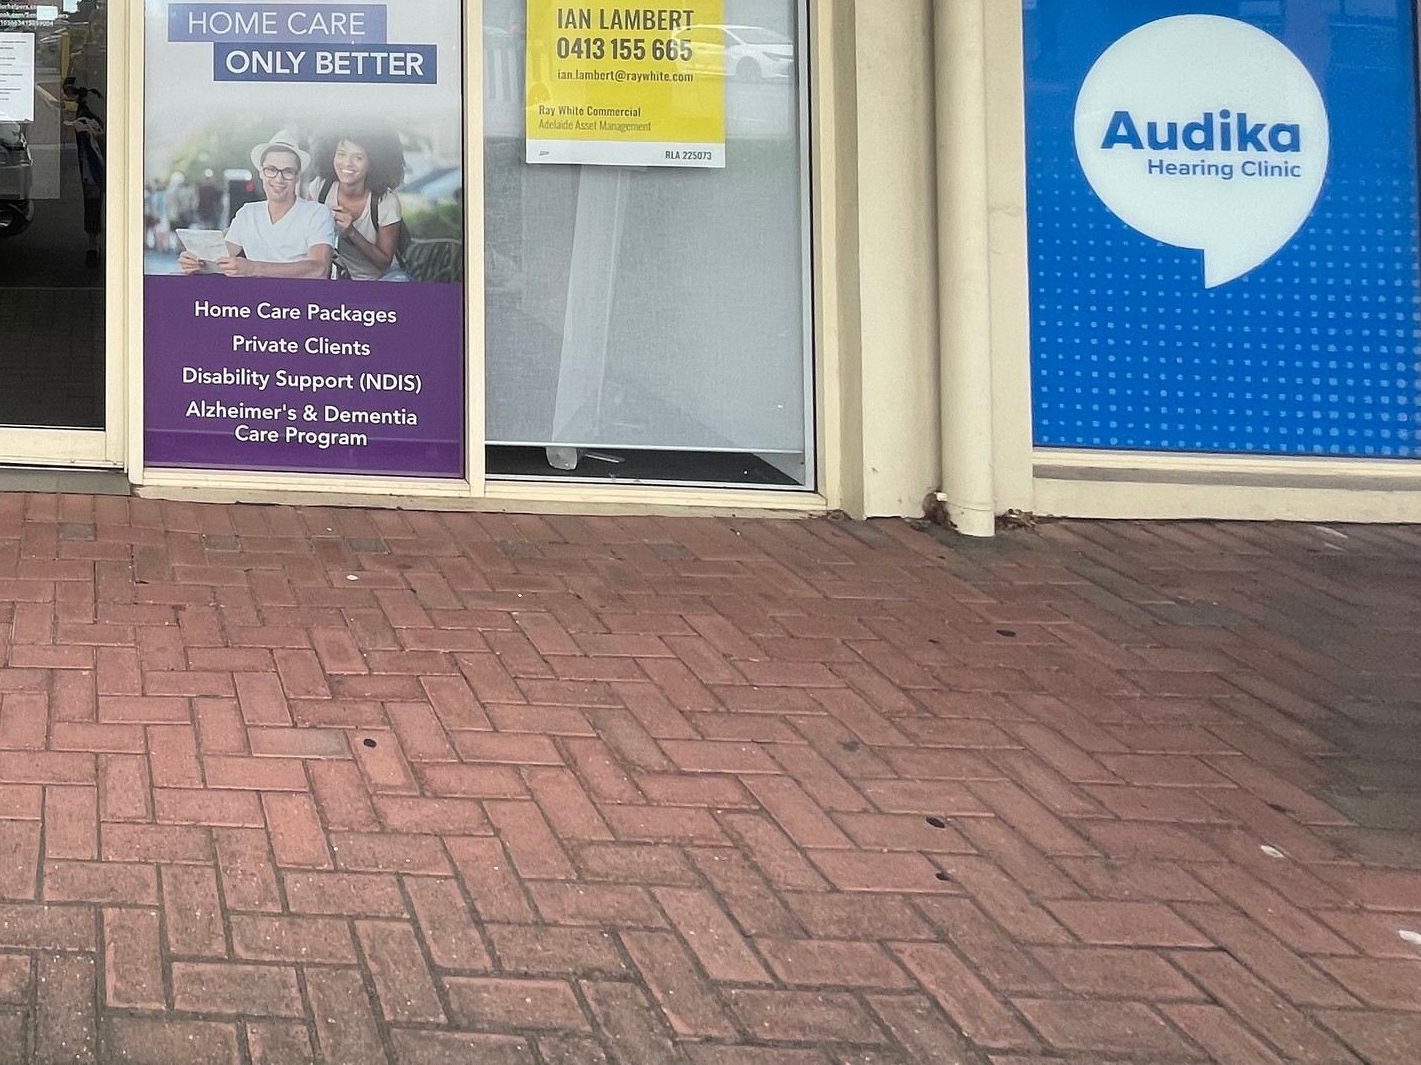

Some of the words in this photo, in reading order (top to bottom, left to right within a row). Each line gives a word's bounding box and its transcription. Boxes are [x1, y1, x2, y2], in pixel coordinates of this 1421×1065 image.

[188, 12, 278, 35] HOME
[287, 12, 366, 35] CARE
[557, 9, 592, 30] IAN
[599, 9, 694, 32] LAMBERT
[556, 37, 605, 60] 0413
[611, 38, 646, 61] 155
[651, 39, 693, 62] 665
[226, 50, 306, 75] ONLY
[316, 52, 424, 76] BETTER
[557, 69, 694, 83] ian.lambert@raywhite.com
[539, 105, 556, 117] Ray
[558, 106, 584, 117] White
[587, 106, 641, 117] Commercial
[539, 119, 574, 130] Adelaide
[575, 120, 597, 131] Asset
[599, 121, 652, 133] Management
[1100, 108, 1302, 153] Audika
[665, 151, 681, 160] RLA
[682, 151, 713, 161] 225073
[1147, 159, 1234, 180] Hearing
[1241, 160, 1302, 178] Clinic
[195, 300, 251, 318] Home
[257, 302, 301, 320] Care
[307, 304, 397, 327] Packages
[233, 335, 299, 354] Private
[304, 337, 371, 356] Clients
[183, 367, 270, 390] Disability
[275, 370, 354, 392] Support
[359, 373, 422, 394] (NDIS)
[186, 400, 297, 421] Alzheimer's
[302, 405, 319, 422] &
[324, 405, 418, 426] Dementia
[235, 425, 280, 443] Care
[285, 426, 368, 449] Program
